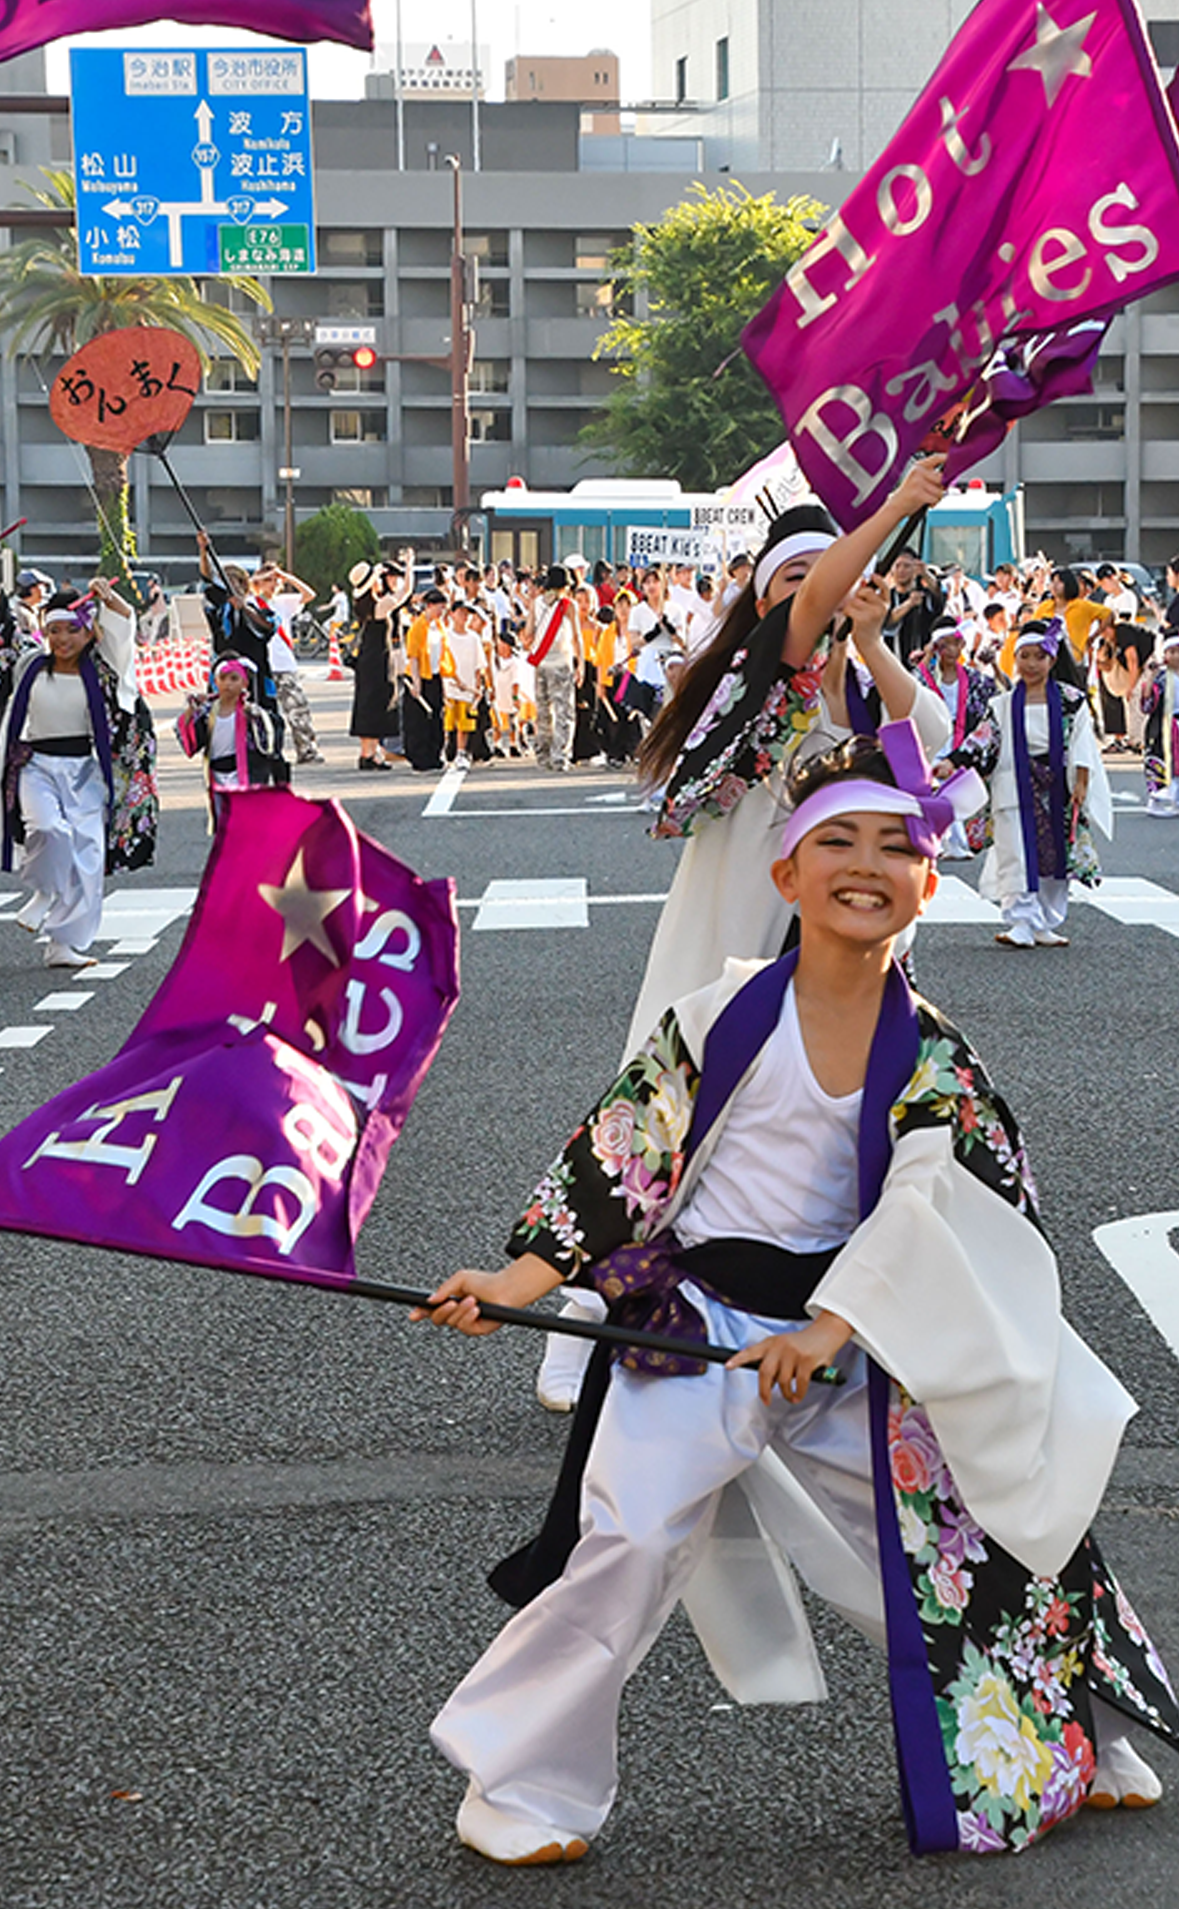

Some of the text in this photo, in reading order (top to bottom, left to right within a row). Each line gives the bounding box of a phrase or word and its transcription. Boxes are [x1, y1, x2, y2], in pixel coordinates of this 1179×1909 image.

[130, 57, 191, 78] 今治駅
[213, 57, 299, 78] 今治市役所
[222, 79, 289, 91] CITY OFFICE
[228, 110, 304, 135] 波方
[81, 151, 138, 179] 松山
[230, 152, 306, 177] 波止浜
[85, 224, 142, 250] 小松
[249, 229, 279, 244] E76
[59, 358, 197, 425] おんまく
